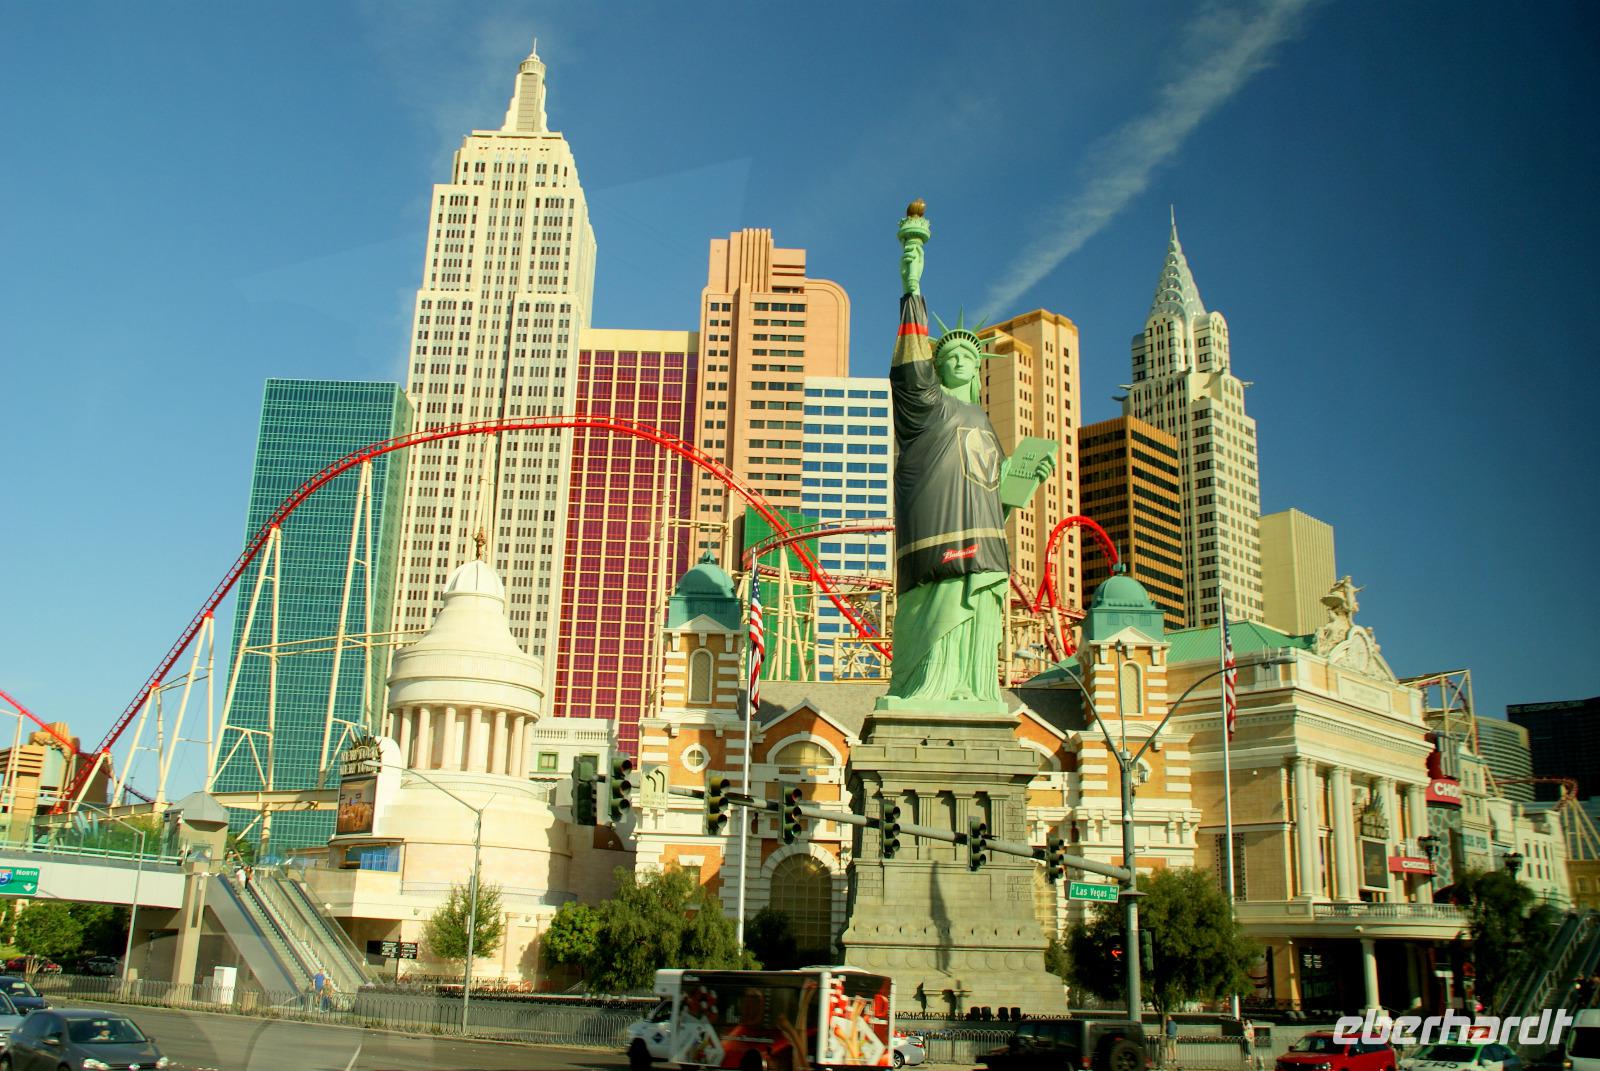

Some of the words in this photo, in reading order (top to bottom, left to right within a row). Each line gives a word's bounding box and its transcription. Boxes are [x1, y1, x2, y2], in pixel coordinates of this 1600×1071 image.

[341, 749, 357, 762] NEW
[358, 746, 379, 760] YORK
[340, 762, 356, 776] NEW
[1075, 885, 1088, 896] Las
[1090, 887, 1107, 899] Vegas
